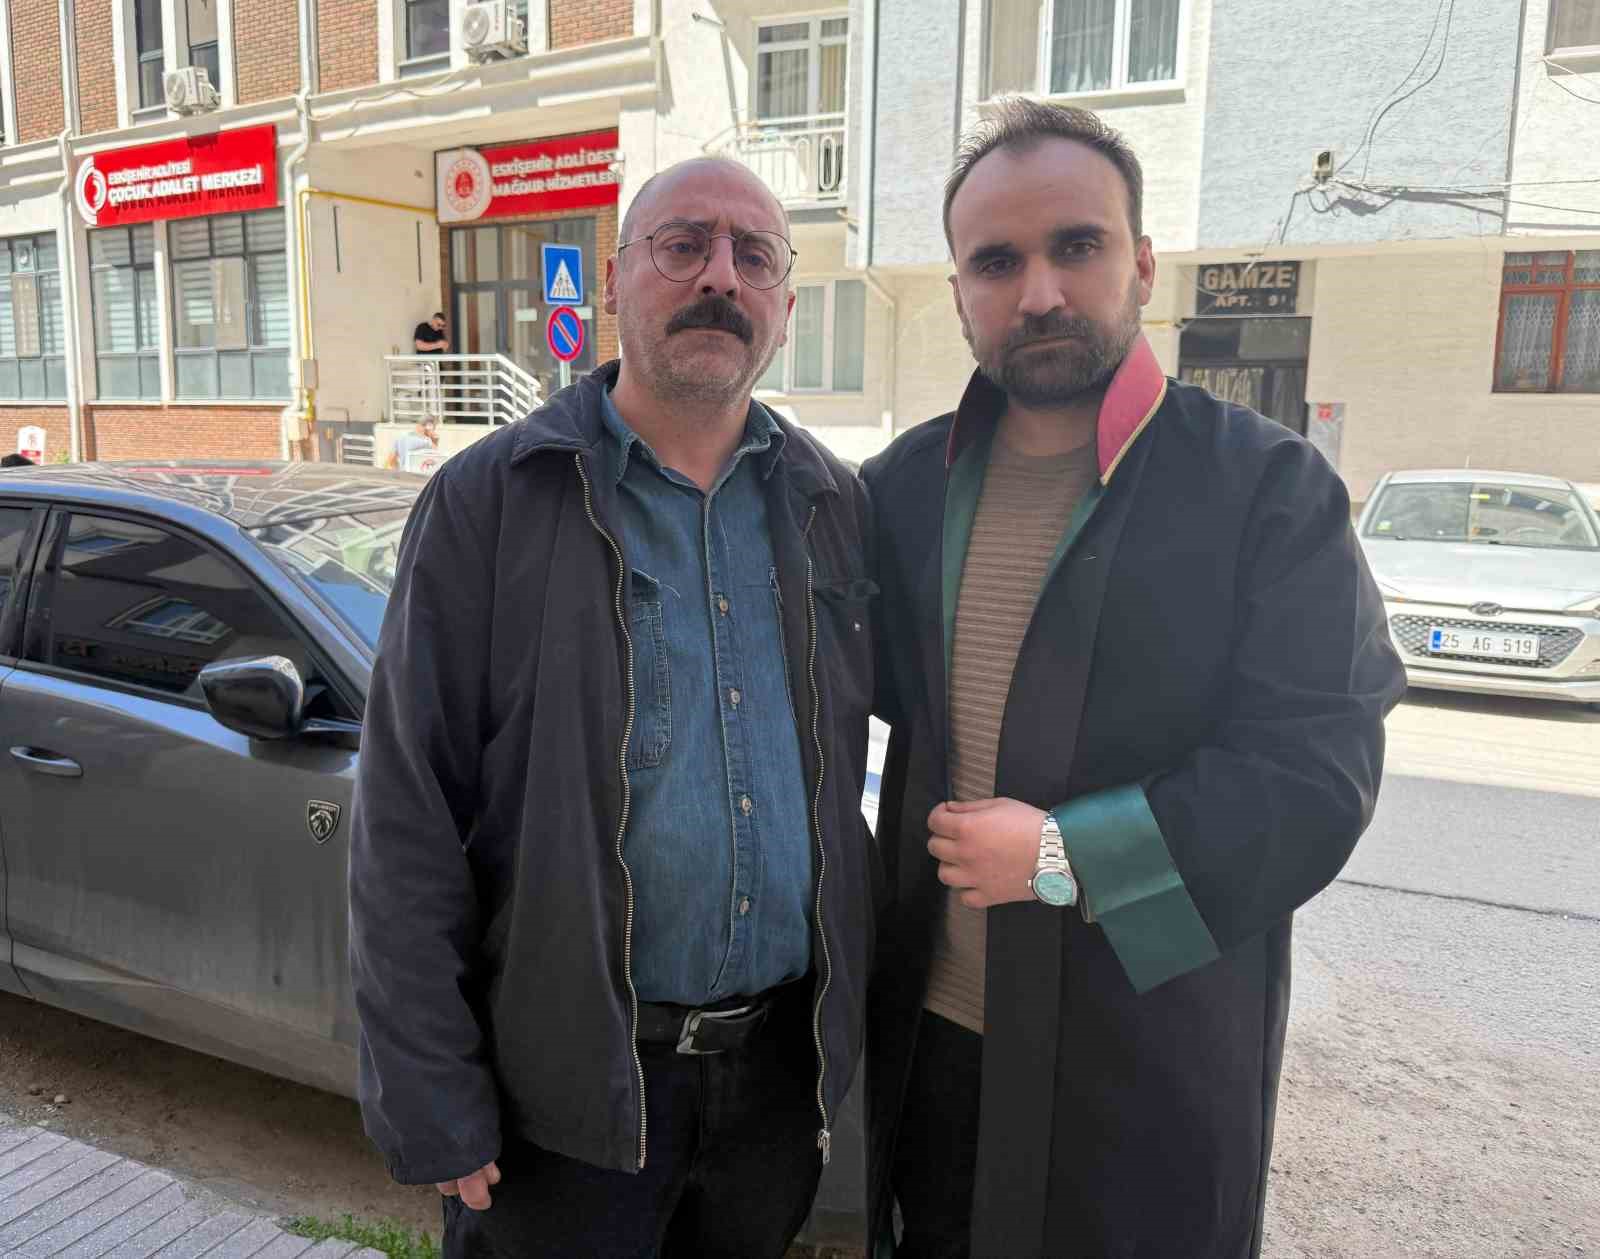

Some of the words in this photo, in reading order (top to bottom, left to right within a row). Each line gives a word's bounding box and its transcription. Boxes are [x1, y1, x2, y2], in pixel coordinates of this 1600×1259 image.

[492, 155, 553, 177] ESKİŞEHİR
[556, 148, 585, 169] ADLİ
[107, 178, 154, 207] ÇOCUK
[151, 174, 202, 199] ADALET
[202, 164, 262, 191] MERKEZİ
[491, 174, 546, 198] MAĞDUR
[1204, 266, 1293, 290] GAMZE
[1442, 633, 1460, 649] 25
[1472, 636, 1491, 652] AG
[1503, 637, 1532, 655] 519
